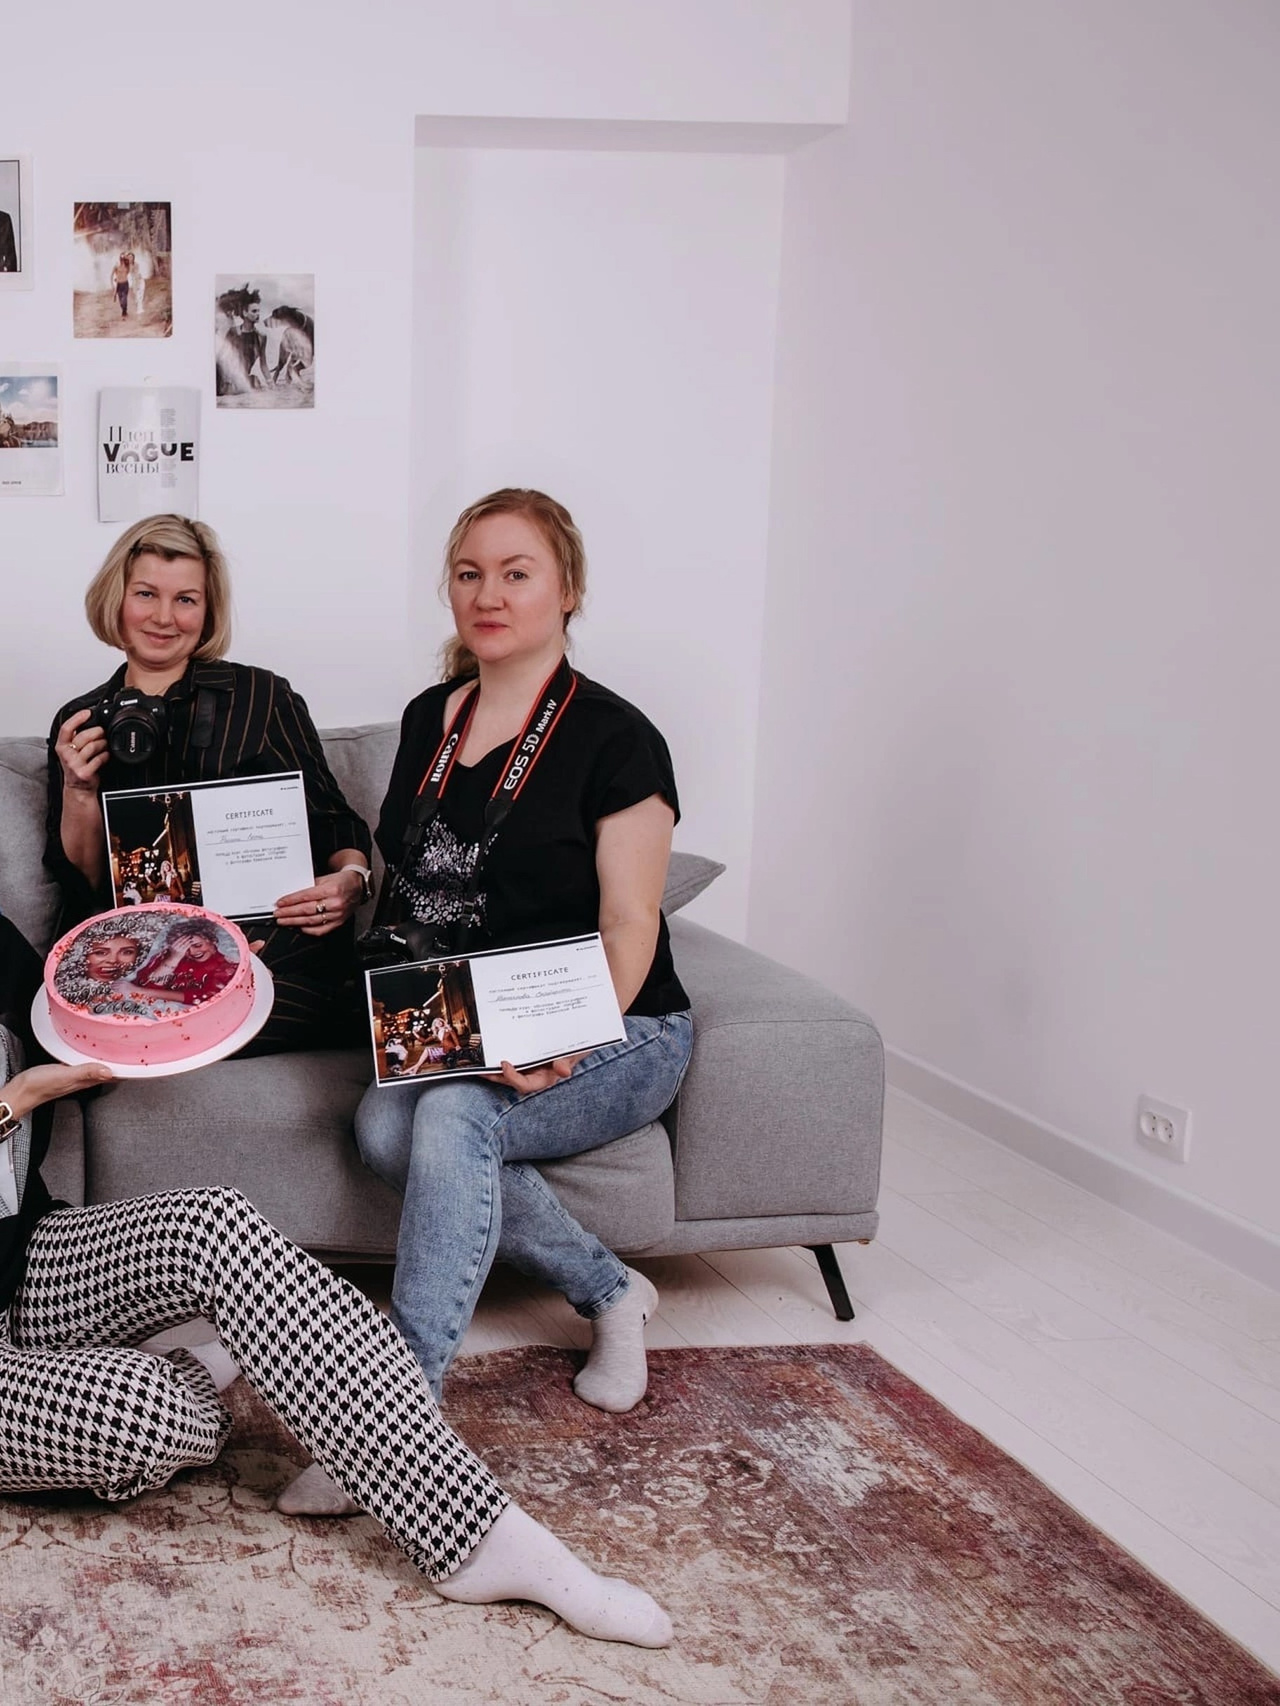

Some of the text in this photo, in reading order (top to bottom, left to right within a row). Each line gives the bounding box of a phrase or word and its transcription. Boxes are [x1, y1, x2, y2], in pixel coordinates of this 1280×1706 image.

[103, 443, 194, 462] VOGUE
[128, 731, 136, 753] Canon
[503, 698, 558, 791] EOS 5D Mark IV
[429, 732, 460, 783] Canon
[225, 808, 274, 820] CERTIFICATE
[510, 966, 570, 981] CERTIFICATE
